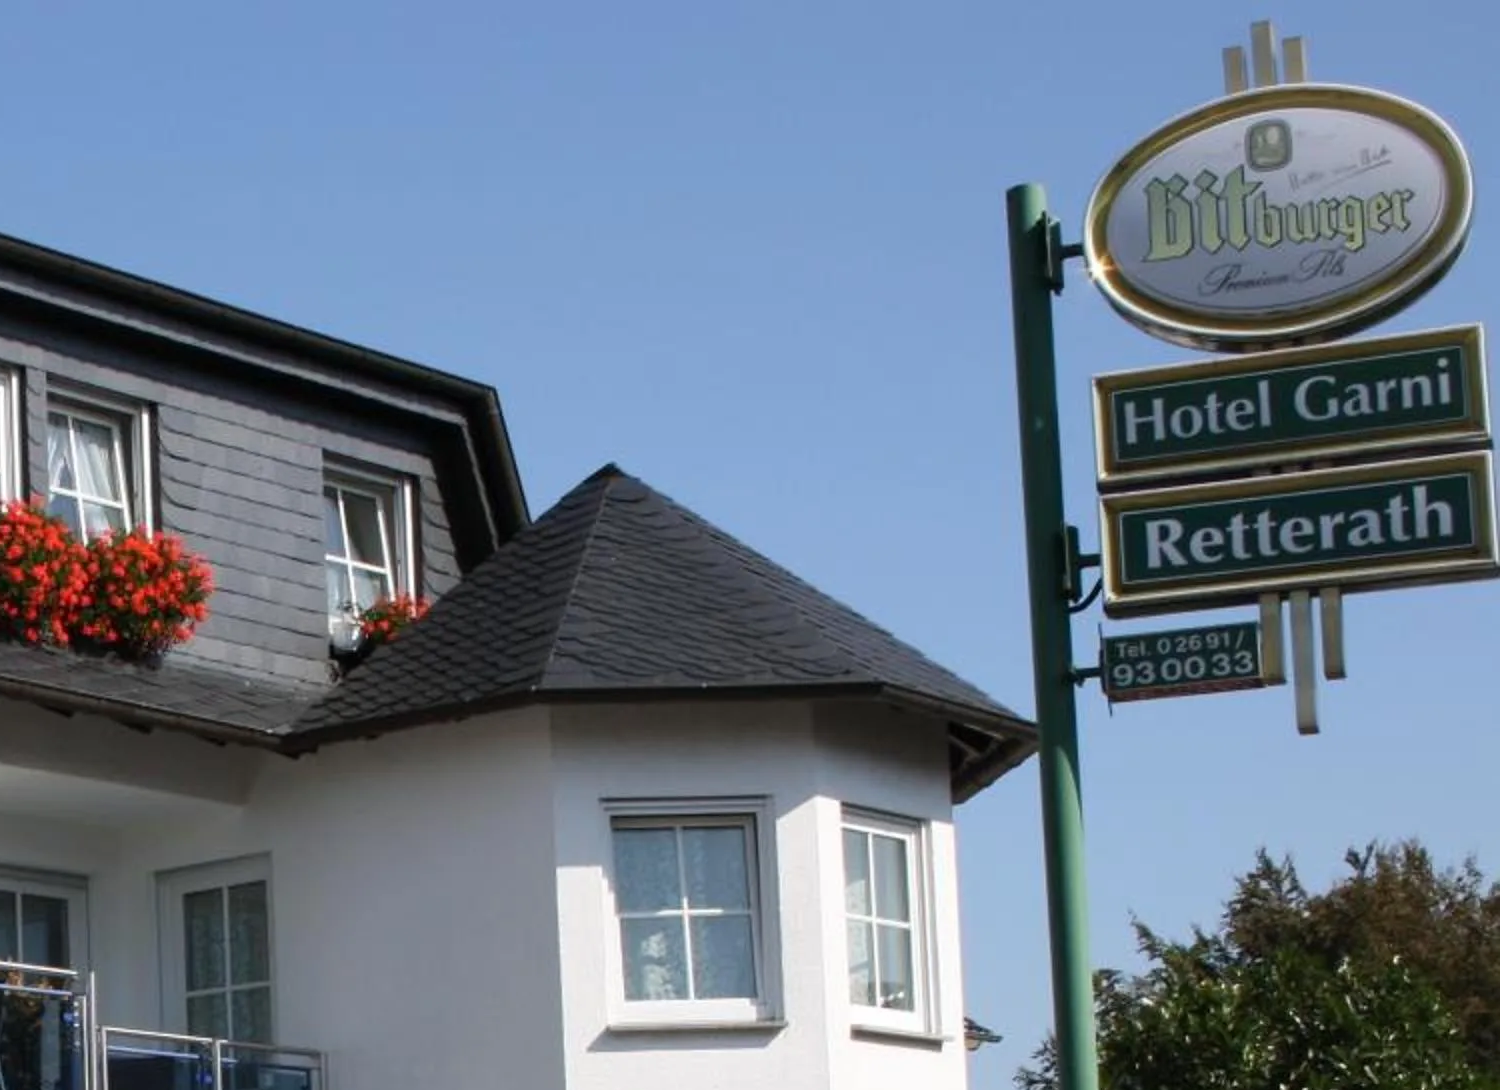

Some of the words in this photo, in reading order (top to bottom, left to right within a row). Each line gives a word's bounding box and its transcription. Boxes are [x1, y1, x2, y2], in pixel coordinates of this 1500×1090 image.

[1141, 164, 1415, 263] Bitburger
[1123, 379, 1271, 445] Hotel
[1293, 356, 1451, 422] Garni
[1144, 484, 1454, 570] Retterath
[1115, 641, 1151, 659] Tel.
